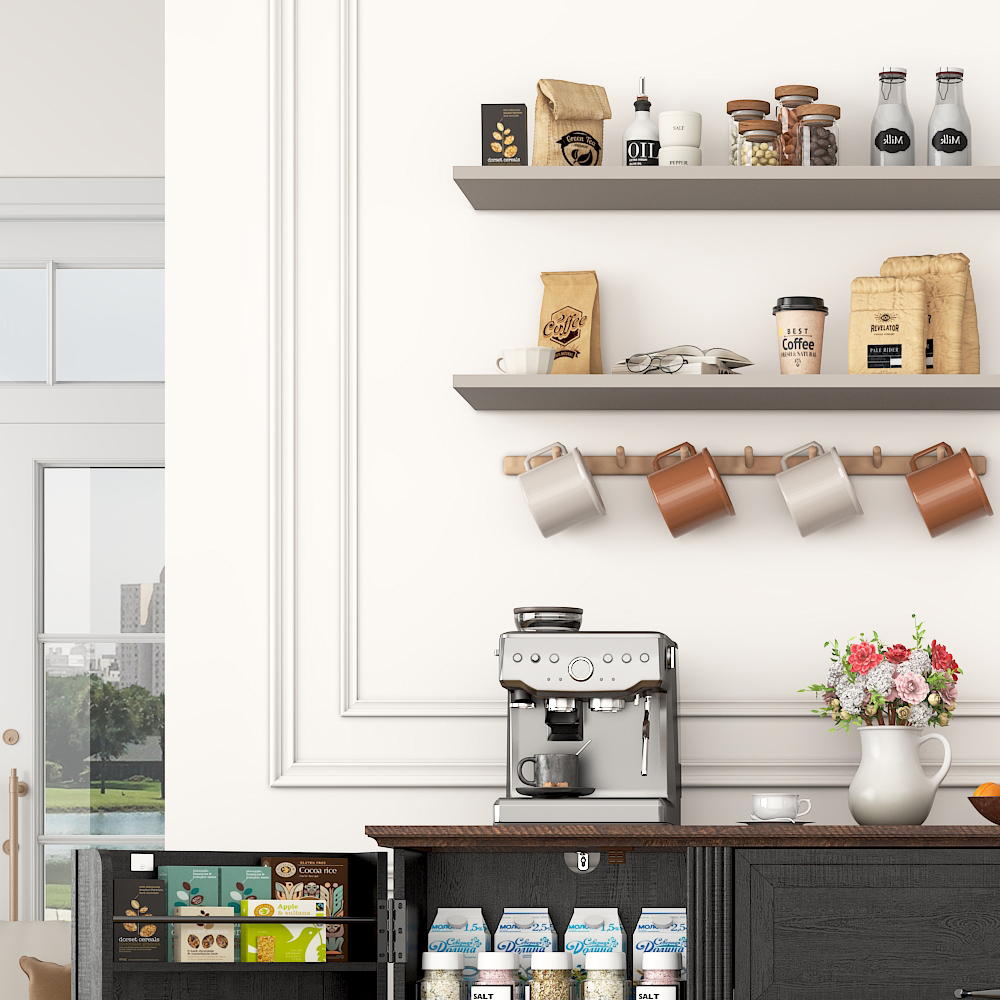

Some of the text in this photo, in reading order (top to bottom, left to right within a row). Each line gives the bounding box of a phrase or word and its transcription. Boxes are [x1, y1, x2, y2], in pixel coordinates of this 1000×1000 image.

[566, 134, 585, 142] Green
[585, 136, 597, 147] Tea
[628, 142, 660, 158] OIL
[543, 313, 588, 339] Coffee
[870, 324, 900, 332] REVELATOR
[782, 338, 815, 351] Coffee
[299, 866, 337, 874] Cocoa rice
[497, 941, 545, 954] Долина
[566, 941, 613, 955] Долина
